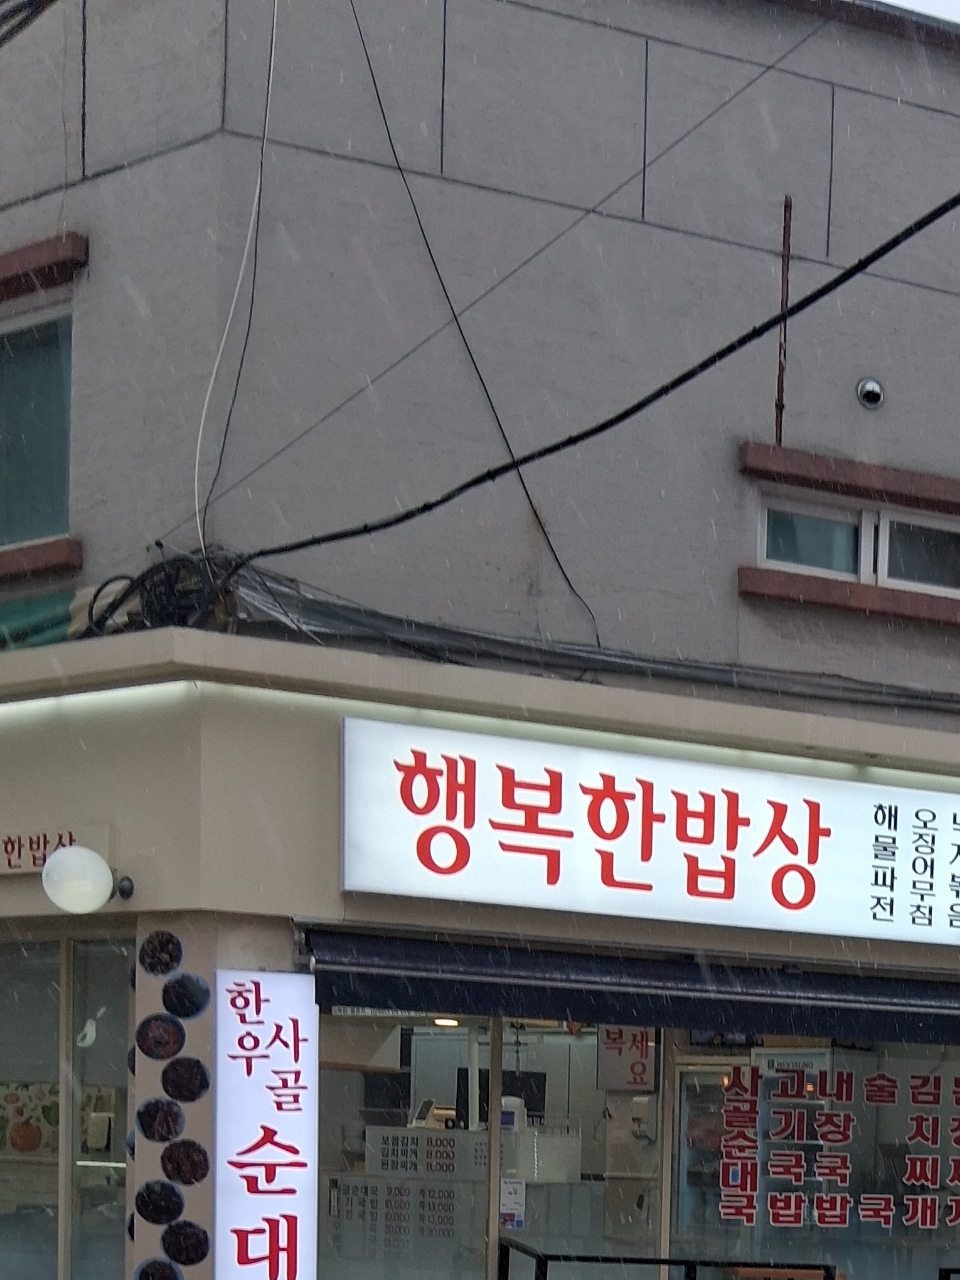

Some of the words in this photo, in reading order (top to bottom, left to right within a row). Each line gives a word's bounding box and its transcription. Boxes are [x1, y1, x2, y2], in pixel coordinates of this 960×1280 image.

[392, 748, 832, 911] 행복한밥상
[869, 803, 899, 923] 해물파전
[908, 808, 939, 928] 오징어무침
[226, 980, 270, 1078] 한우
[265, 1017, 309, 1112] 사골
[719, 1066, 763, 1227] 사골순대국
[768, 1068, 809, 1228] 고기국밥
[813, 1069, 856, 1229] 내장국밥
[902, 1074, 942, 1230] 김치찌개
